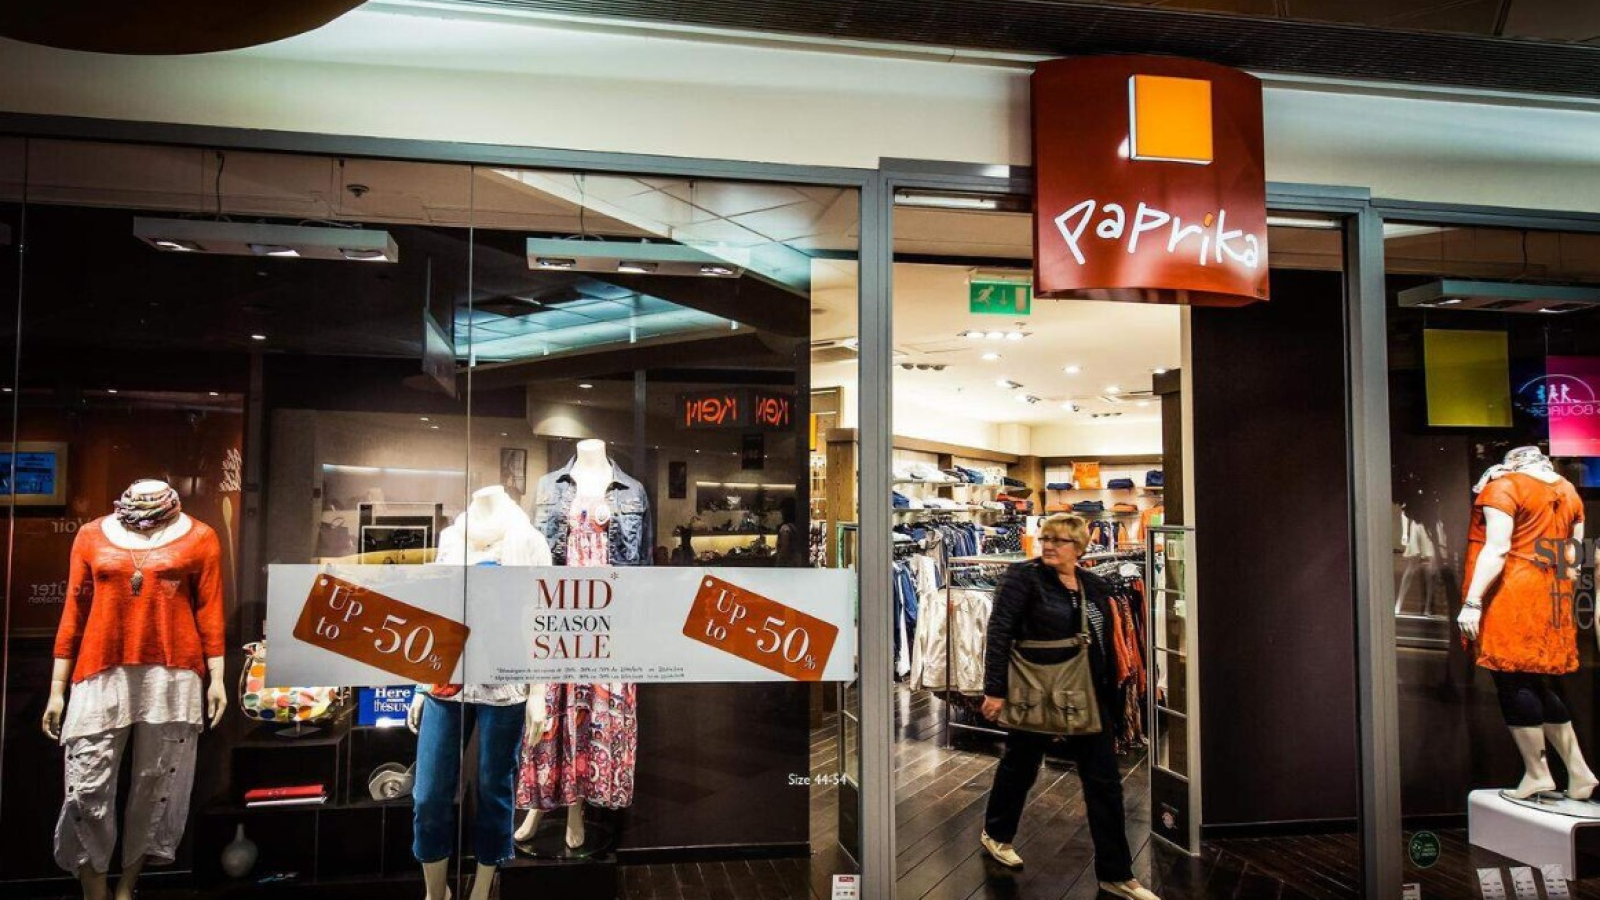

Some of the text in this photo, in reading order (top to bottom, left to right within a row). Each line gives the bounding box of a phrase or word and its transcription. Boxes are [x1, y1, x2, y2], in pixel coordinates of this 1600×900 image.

[329, 584, 363, 622] Up
[716, 589, 747, 626] Up
[315, 616, 340, 640] to
[533, 615, 611, 632] SEASON
[705, 616, 727, 641] to
[533, 634, 611, 660] SALE
[375, 687, 411, 698] Here
[788, 773, 847, 785] Size 44-54
